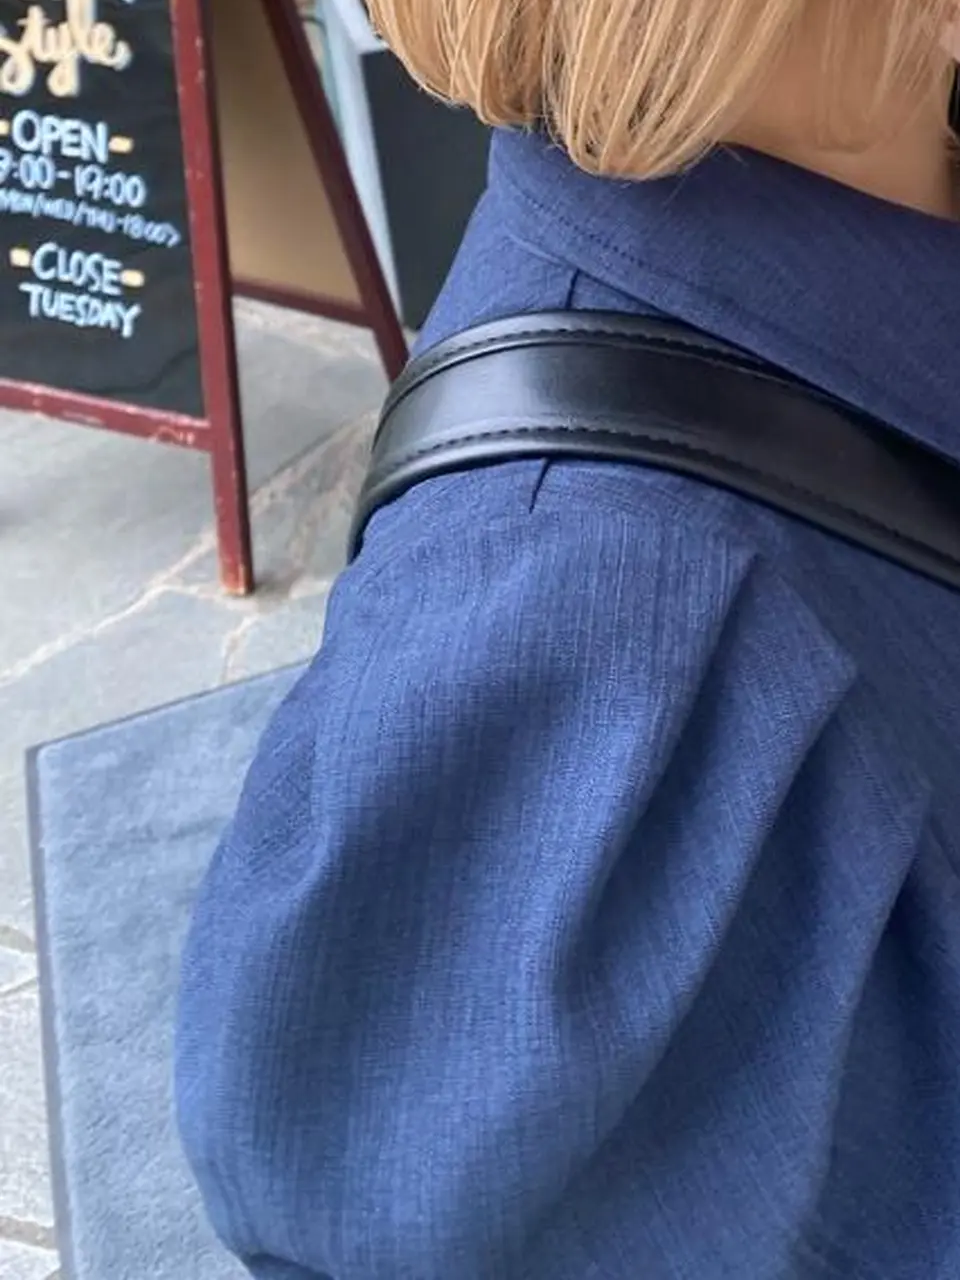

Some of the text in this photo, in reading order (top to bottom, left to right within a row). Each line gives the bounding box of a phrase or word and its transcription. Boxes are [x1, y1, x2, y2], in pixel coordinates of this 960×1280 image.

[12, 109, 109, 165] OPEN
[32, 241, 123, 296] CLOSE
[18, 281, 142, 338] TUESDAY
